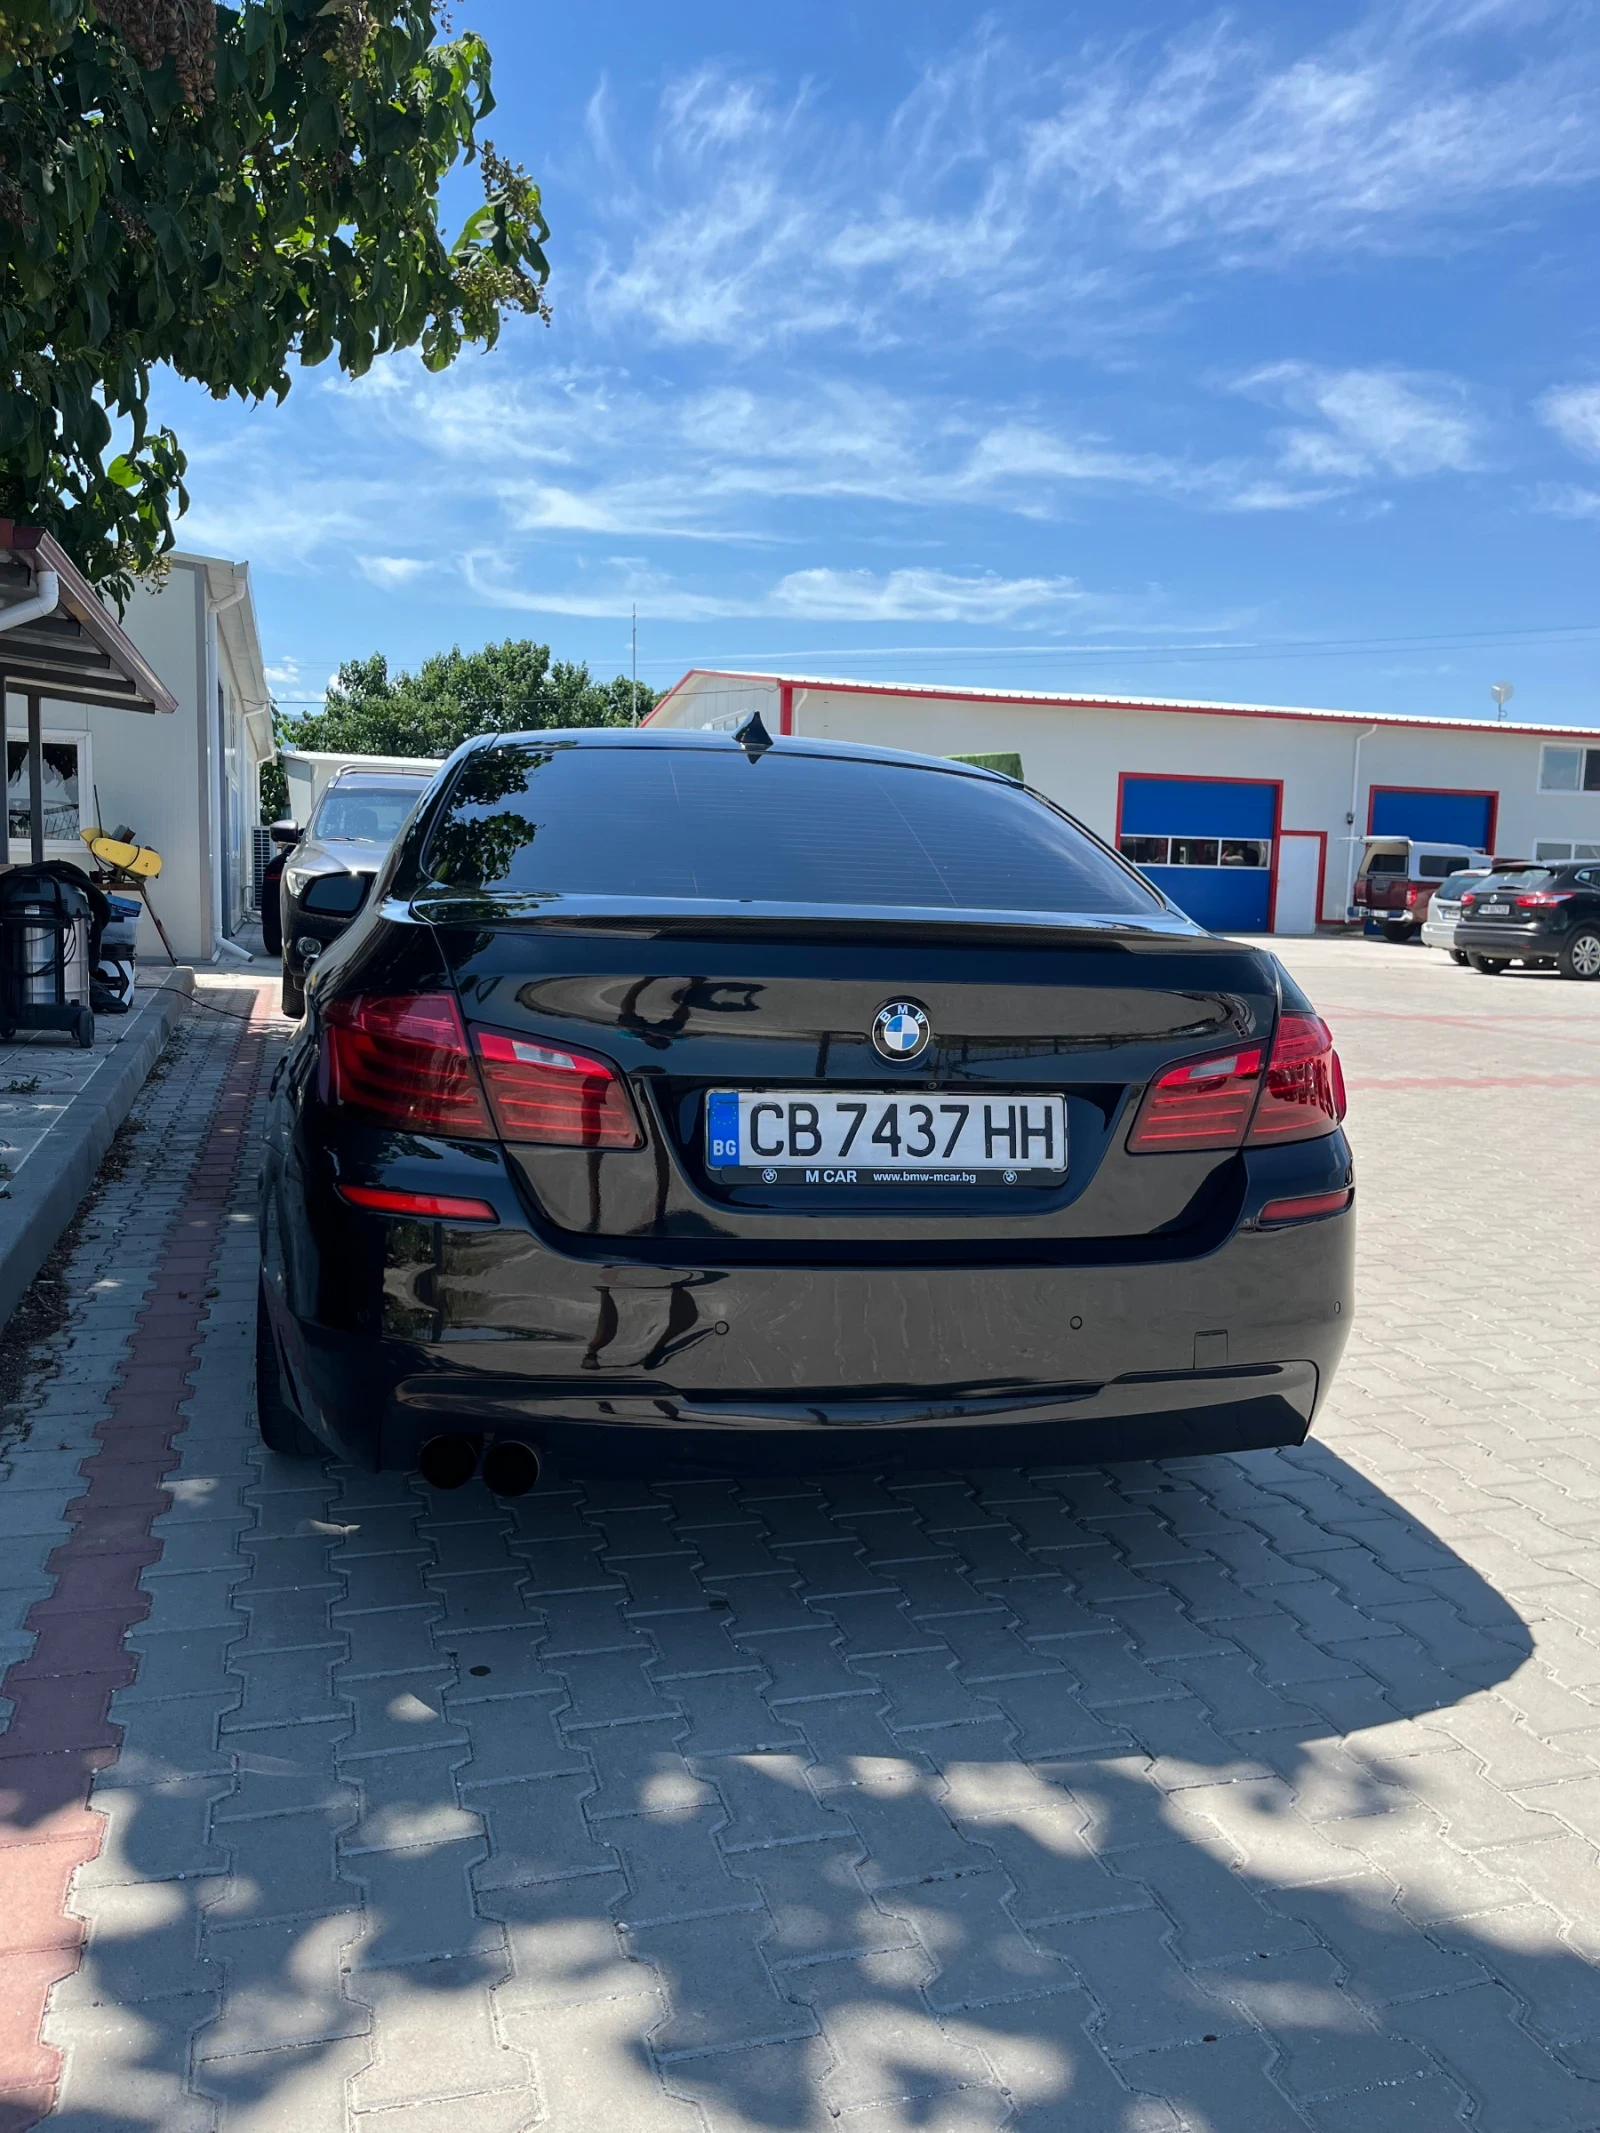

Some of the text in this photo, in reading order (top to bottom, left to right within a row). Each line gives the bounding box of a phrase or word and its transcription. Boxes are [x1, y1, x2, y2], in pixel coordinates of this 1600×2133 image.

[879, 1004, 926, 1024] BMW
[750, 1103, 1053, 1159] CB 7437 HH
[713, 1140, 737, 1156] BG
[805, 1170, 857, 1183] M CAR
[873, 1171, 977, 1184] www.bmw-mcar.bg
